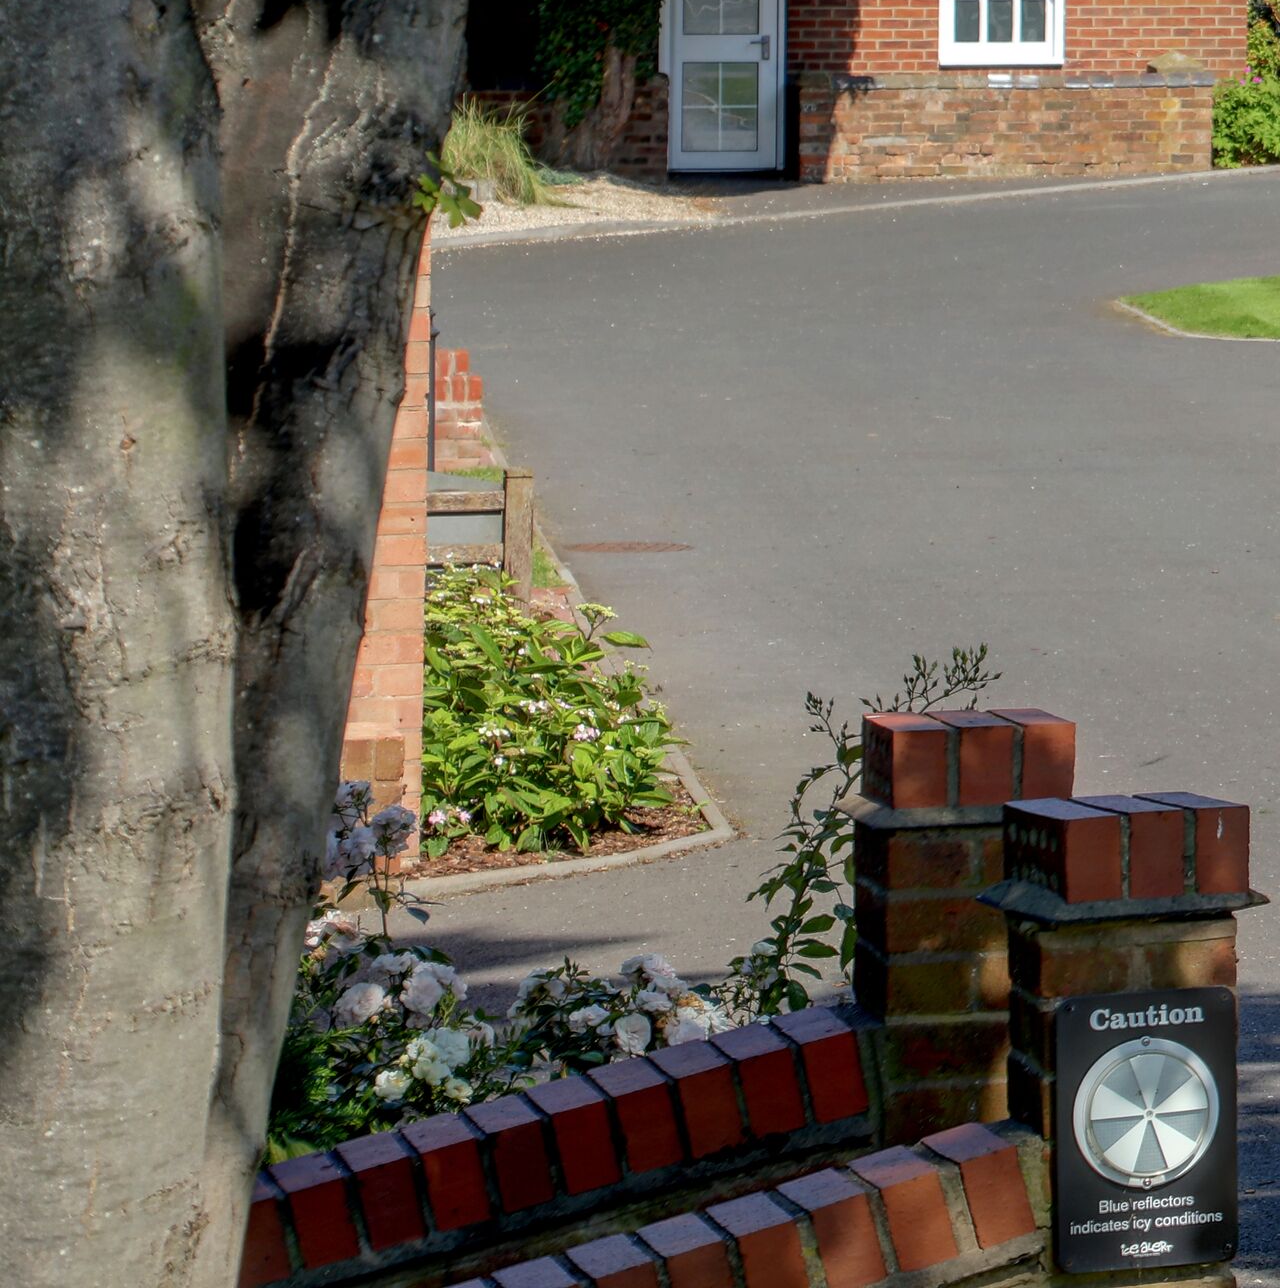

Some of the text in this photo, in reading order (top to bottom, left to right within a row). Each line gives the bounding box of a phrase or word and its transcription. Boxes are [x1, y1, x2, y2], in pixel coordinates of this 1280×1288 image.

[1089, 1003, 1205, 1031] Caution
[1098, 1195, 1195, 1214] Blue reflectors
[1070, 1211, 1223, 1235] indicates icy conditions
